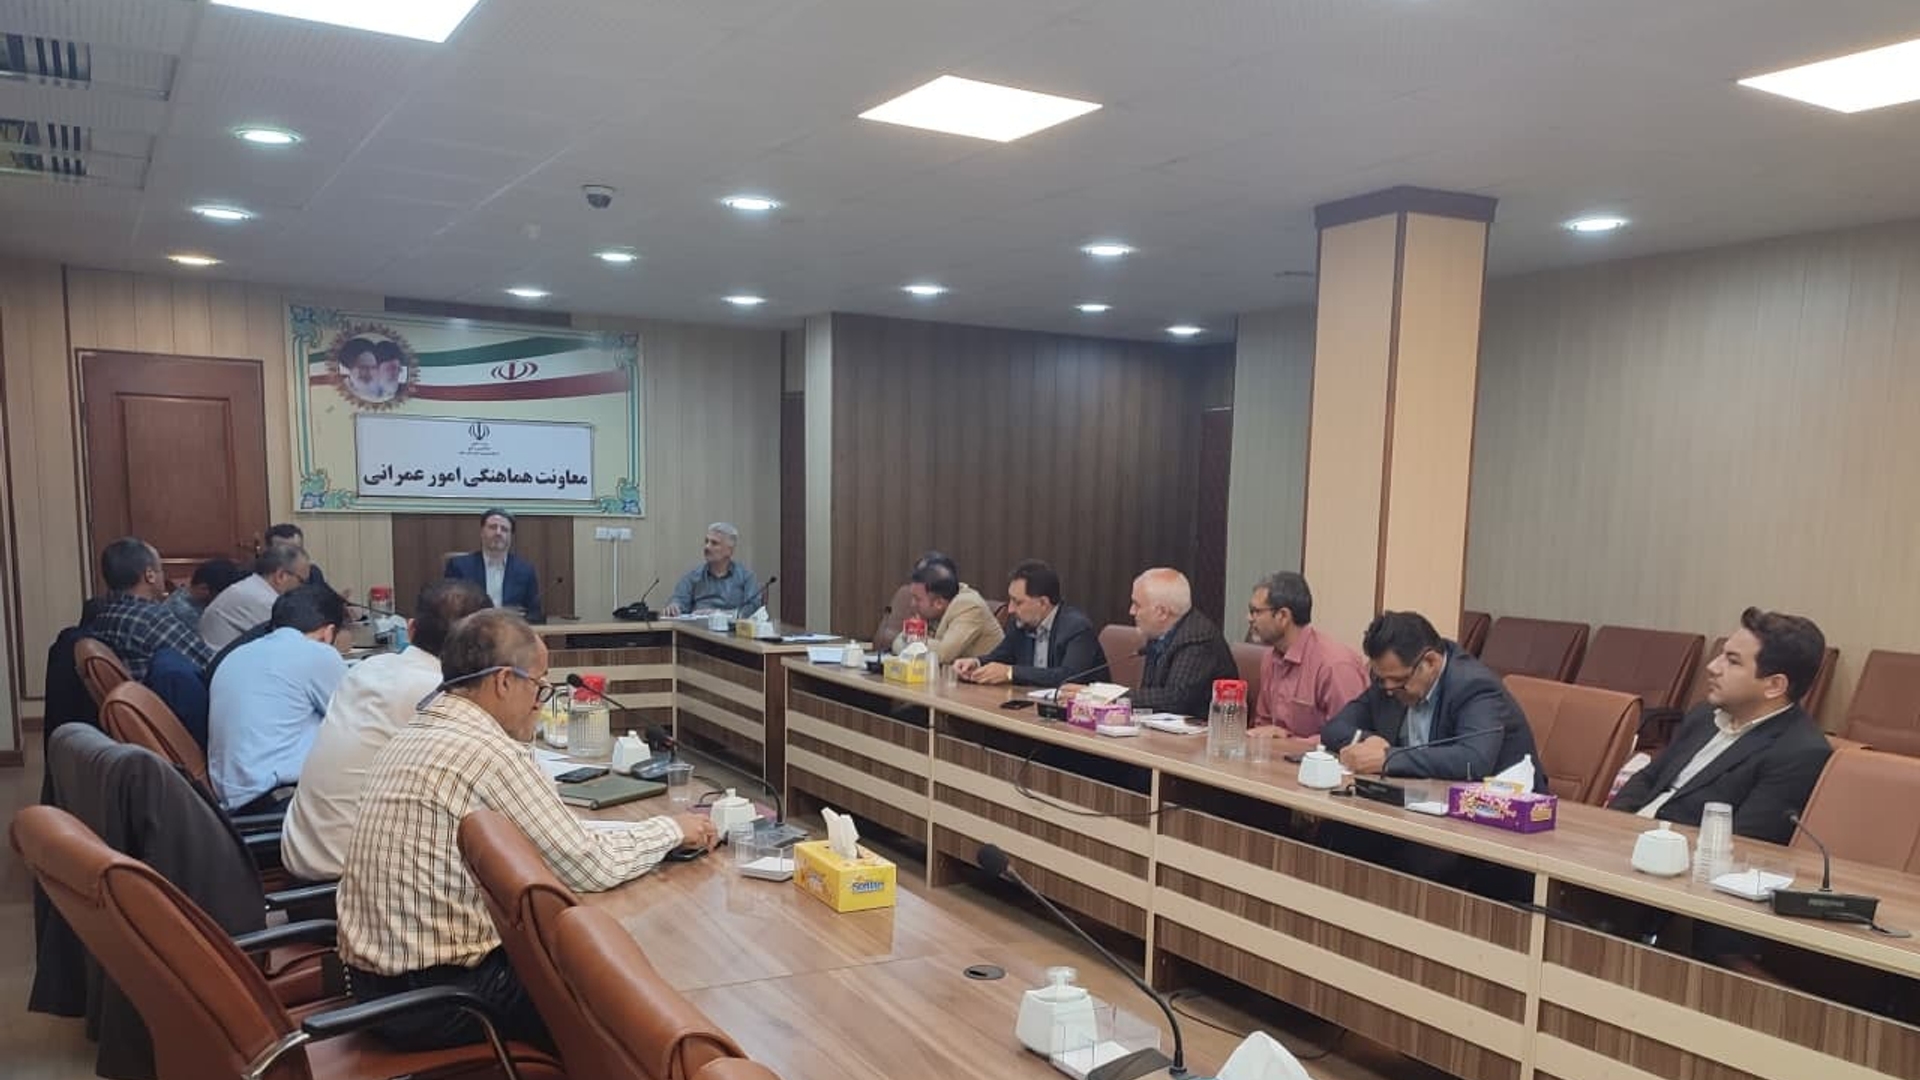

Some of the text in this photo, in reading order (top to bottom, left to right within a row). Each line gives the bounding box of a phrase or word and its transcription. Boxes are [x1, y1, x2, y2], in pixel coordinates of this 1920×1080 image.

[363, 463, 588, 490] معاونت هماهنگی امور عمرانی
